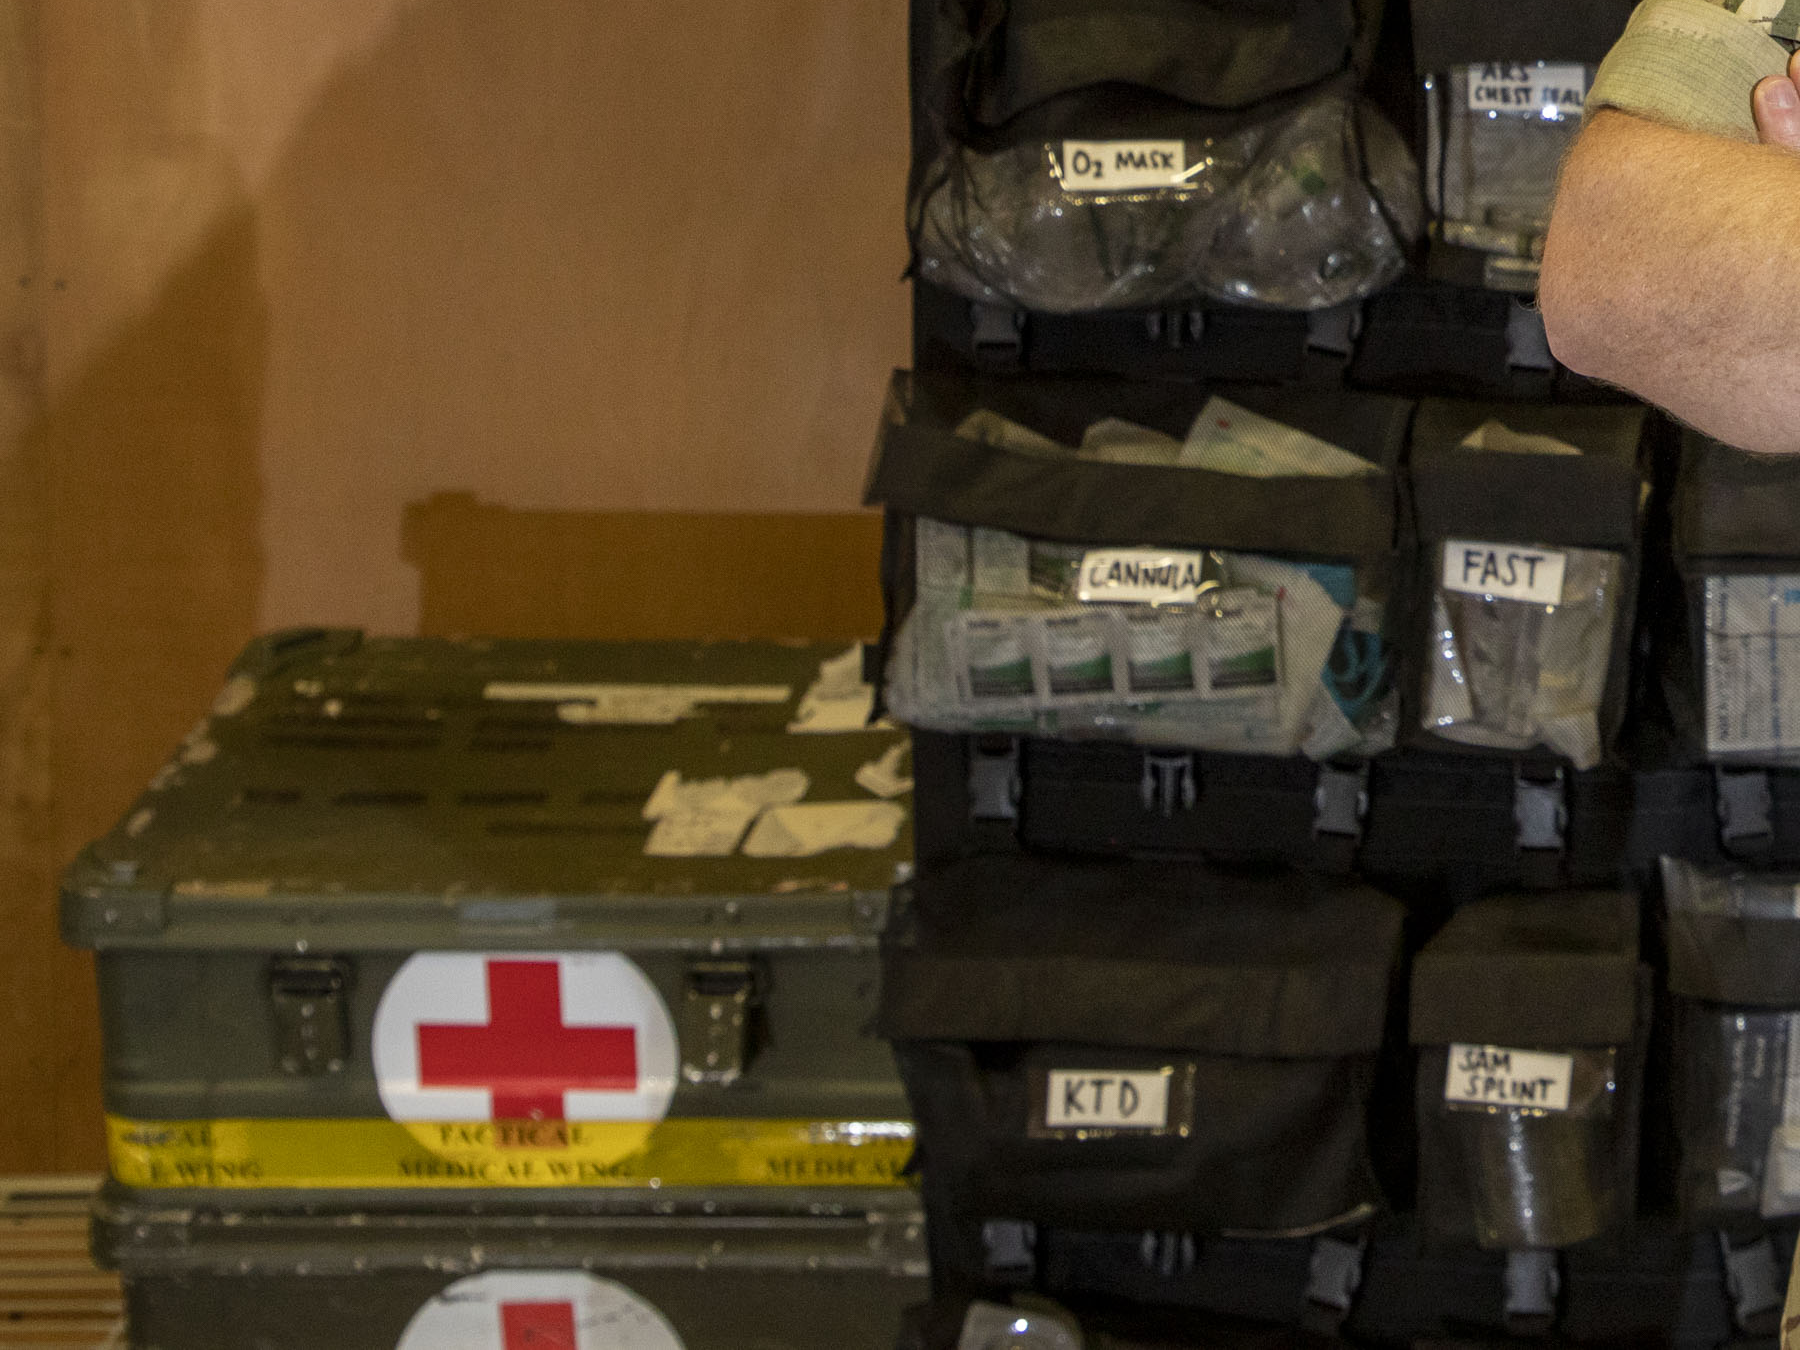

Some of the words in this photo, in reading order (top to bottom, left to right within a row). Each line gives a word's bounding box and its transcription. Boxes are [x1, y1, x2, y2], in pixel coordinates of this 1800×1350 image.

[1475, 85, 1533, 105] CHEST
[1115, 150, 1175, 171] MASK
[1089, 559, 1199, 591] CANNULA
[1462, 548, 1545, 589] FAST
[1458, 1048, 1512, 1075] SAM
[1063, 1077, 1141, 1119] KTD
[1464, 1074, 1556, 1101] SPLINT
[439, 1123, 591, 1146] TACTICAL
[398, 1159, 537, 1180] MEDICAL
[543, 1159, 634, 1180] WING
